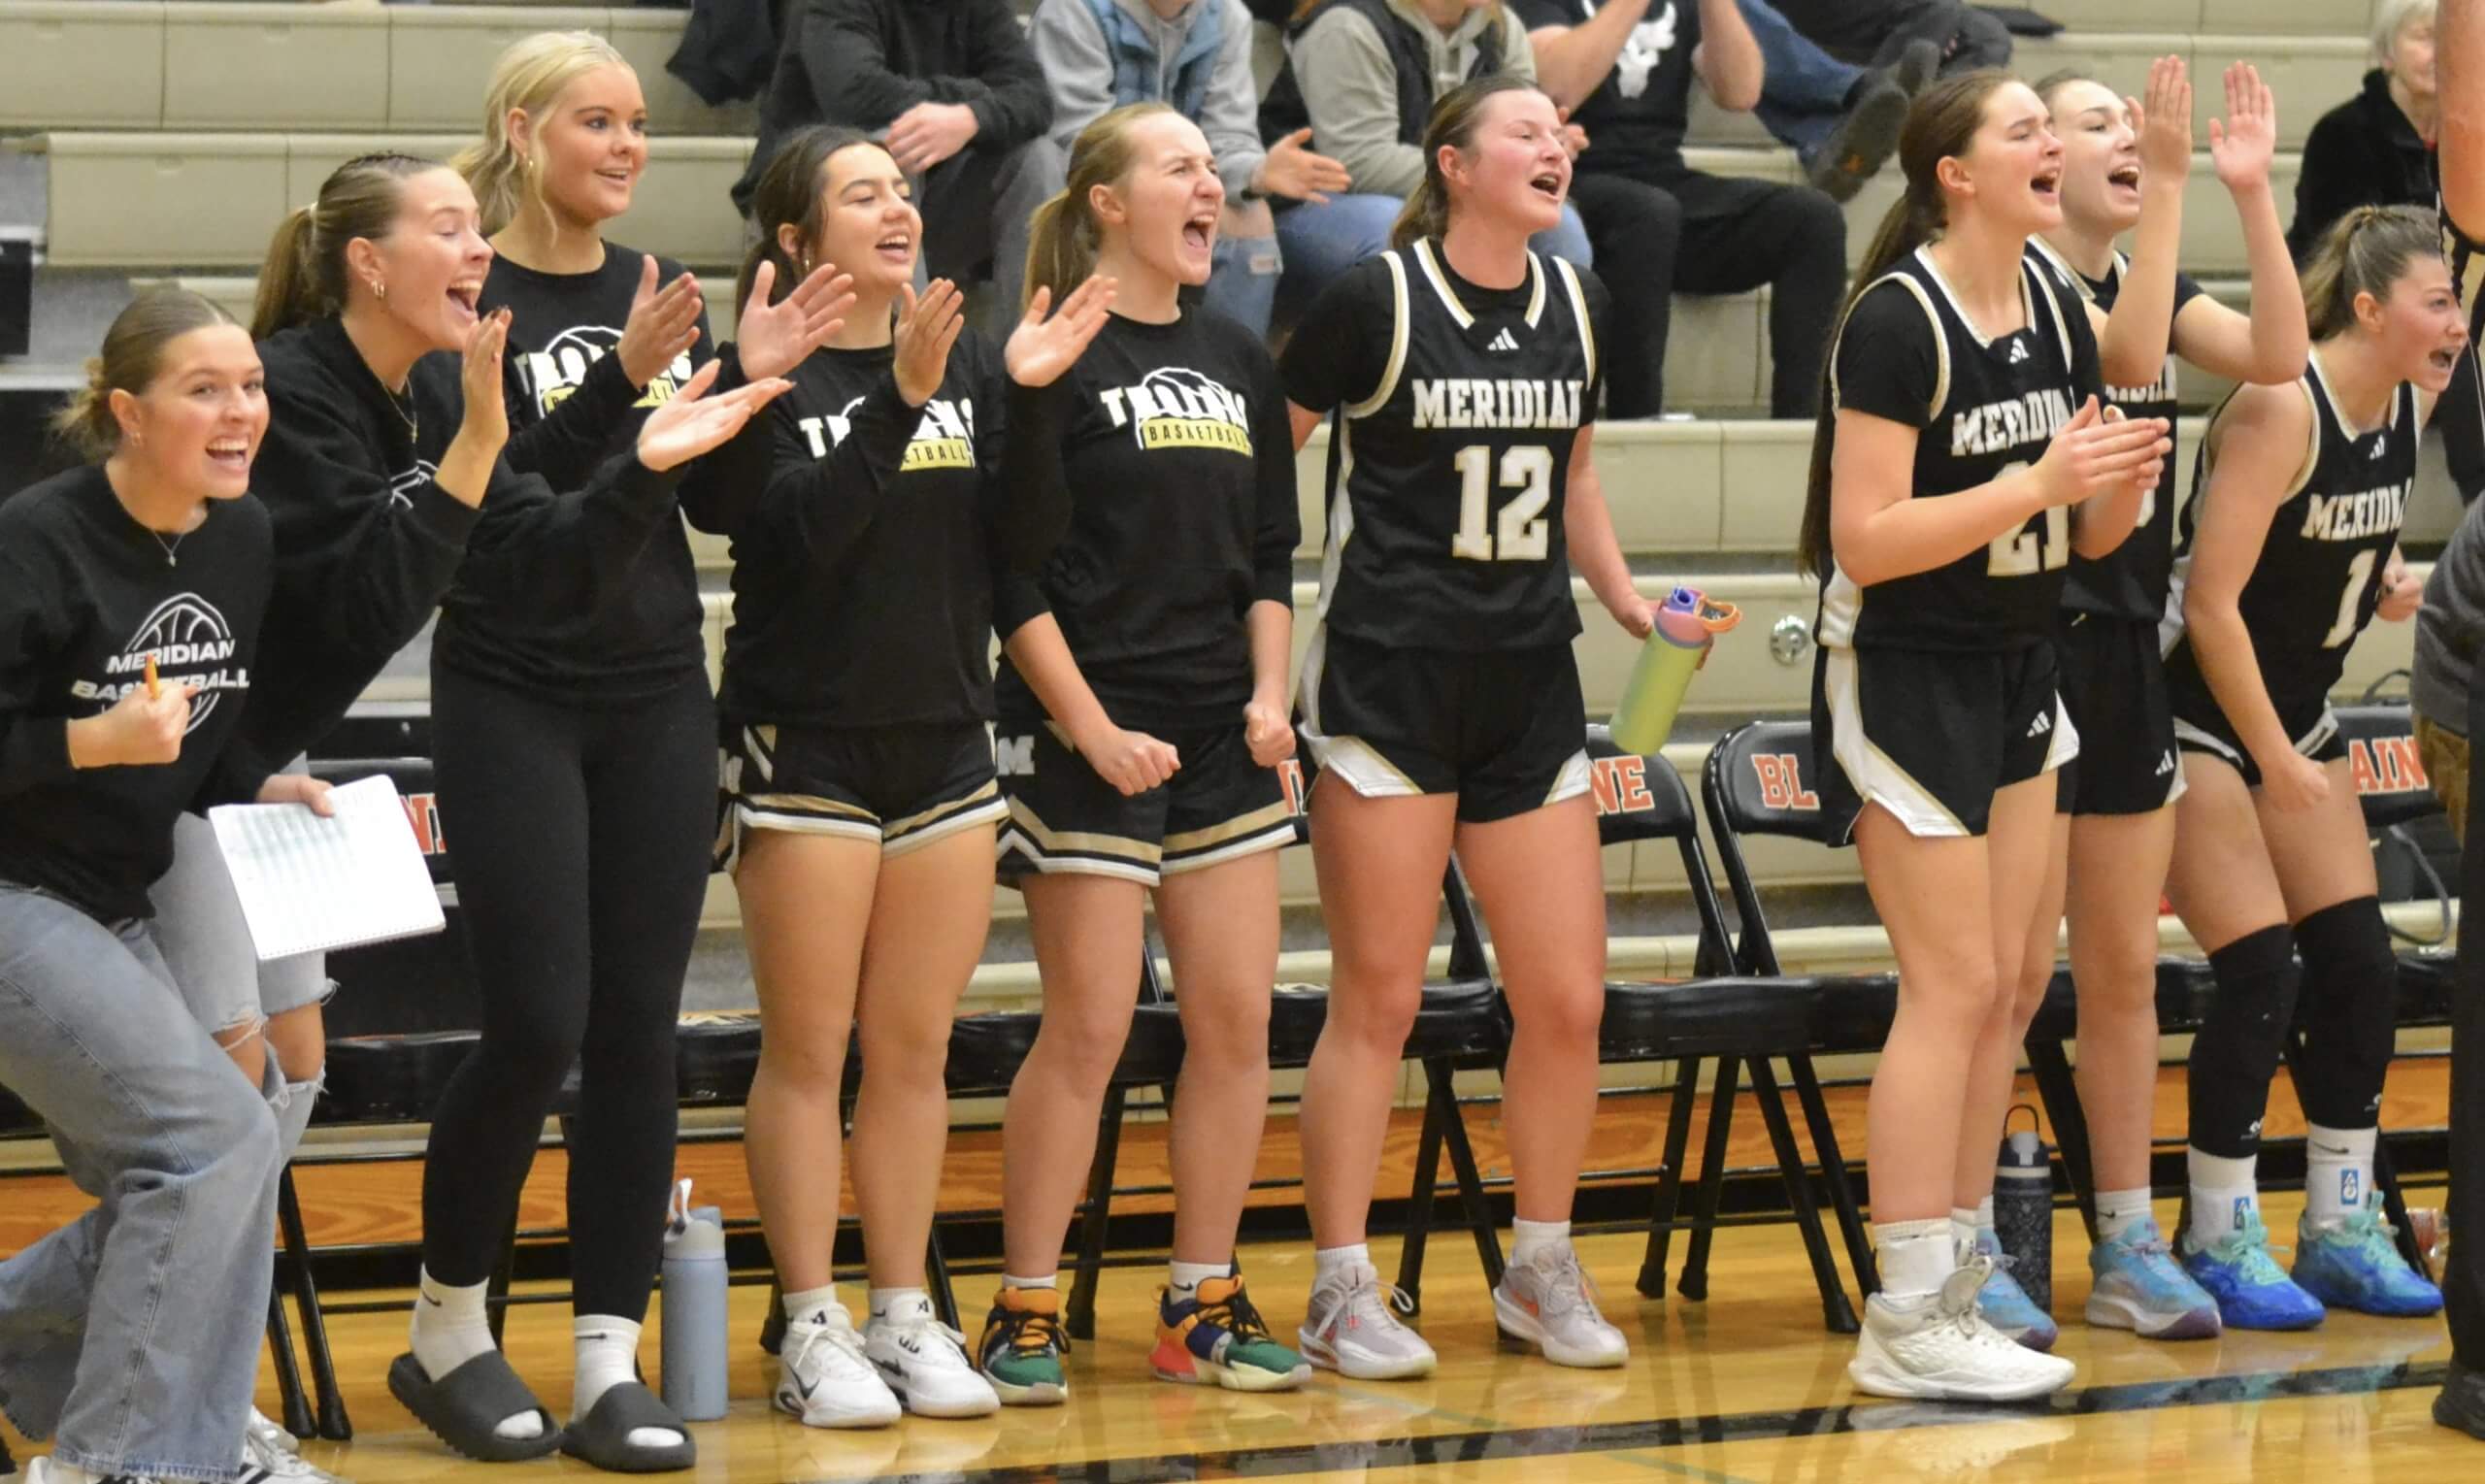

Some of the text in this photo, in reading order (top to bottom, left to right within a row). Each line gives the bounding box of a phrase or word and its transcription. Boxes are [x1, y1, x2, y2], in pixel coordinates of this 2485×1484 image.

[1950, 385, 2075, 456] MERIDIA
[1452, 445, 1554, 561] 12
[2321, 548, 2377, 648] 1
[106, 639, 236, 674] MERIDIAN
